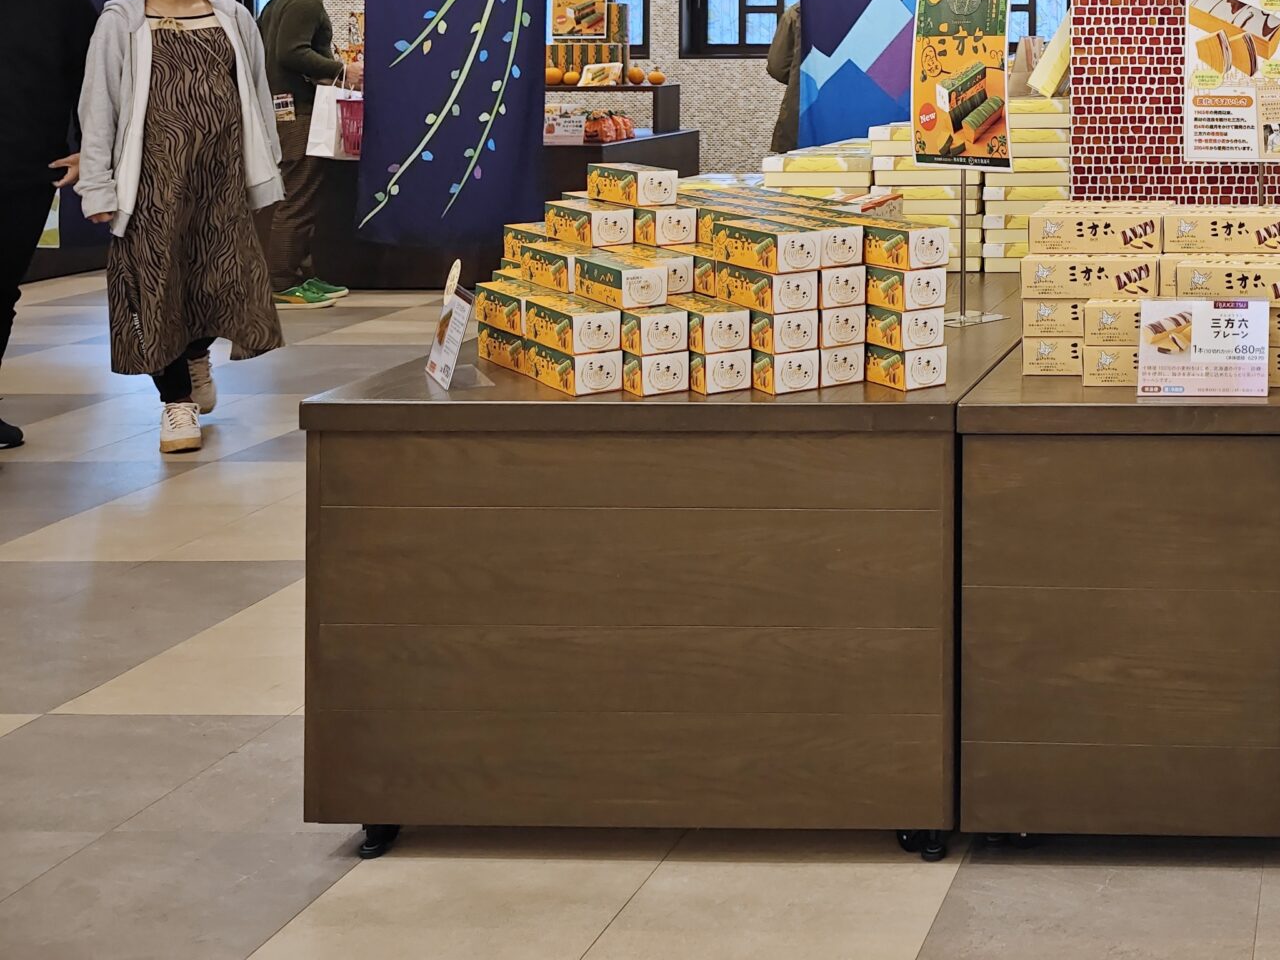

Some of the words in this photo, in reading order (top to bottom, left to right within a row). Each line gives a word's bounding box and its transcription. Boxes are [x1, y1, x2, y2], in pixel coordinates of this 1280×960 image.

[919, 112, 937, 124] New
[1076, 221, 1115, 237] 三方六
[1210, 221, 1249, 237] 三方六
[1068, 266, 1109, 282] 三方六
[1225, 272, 1265, 290] 三方六
[1211, 318, 1249, 329] 三方六
[1213, 330, 1249, 339] プレーン
